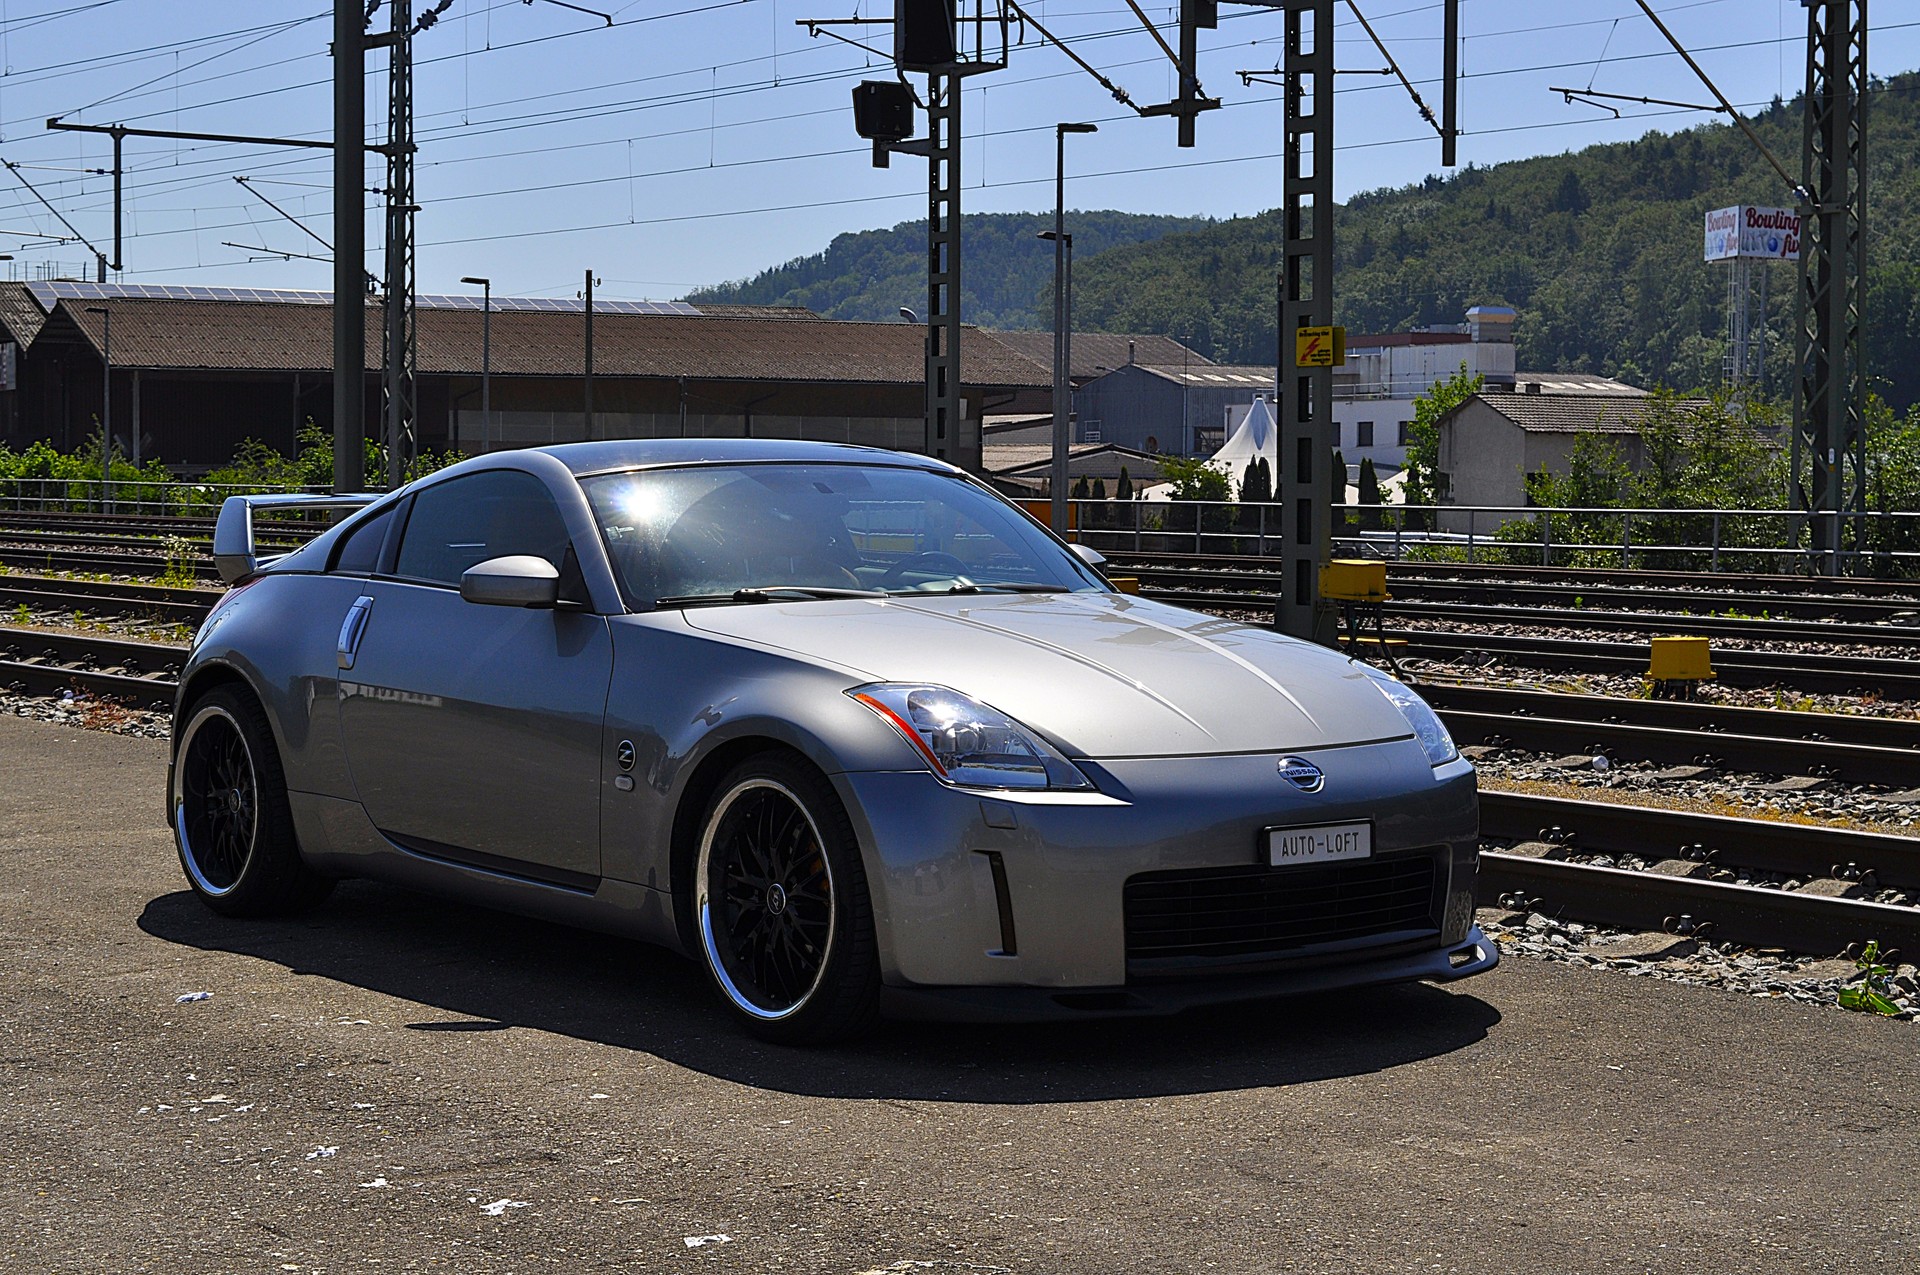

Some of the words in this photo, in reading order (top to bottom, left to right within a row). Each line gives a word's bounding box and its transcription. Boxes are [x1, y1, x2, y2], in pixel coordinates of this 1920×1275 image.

[1707, 211, 1737, 234] Bowling
[1746, 207, 1801, 236] Bowling
[619, 748, 633, 763] Z
[1285, 768, 1319, 776] NISSAN
[1281, 832, 1359, 857] AUTO-LOFT
